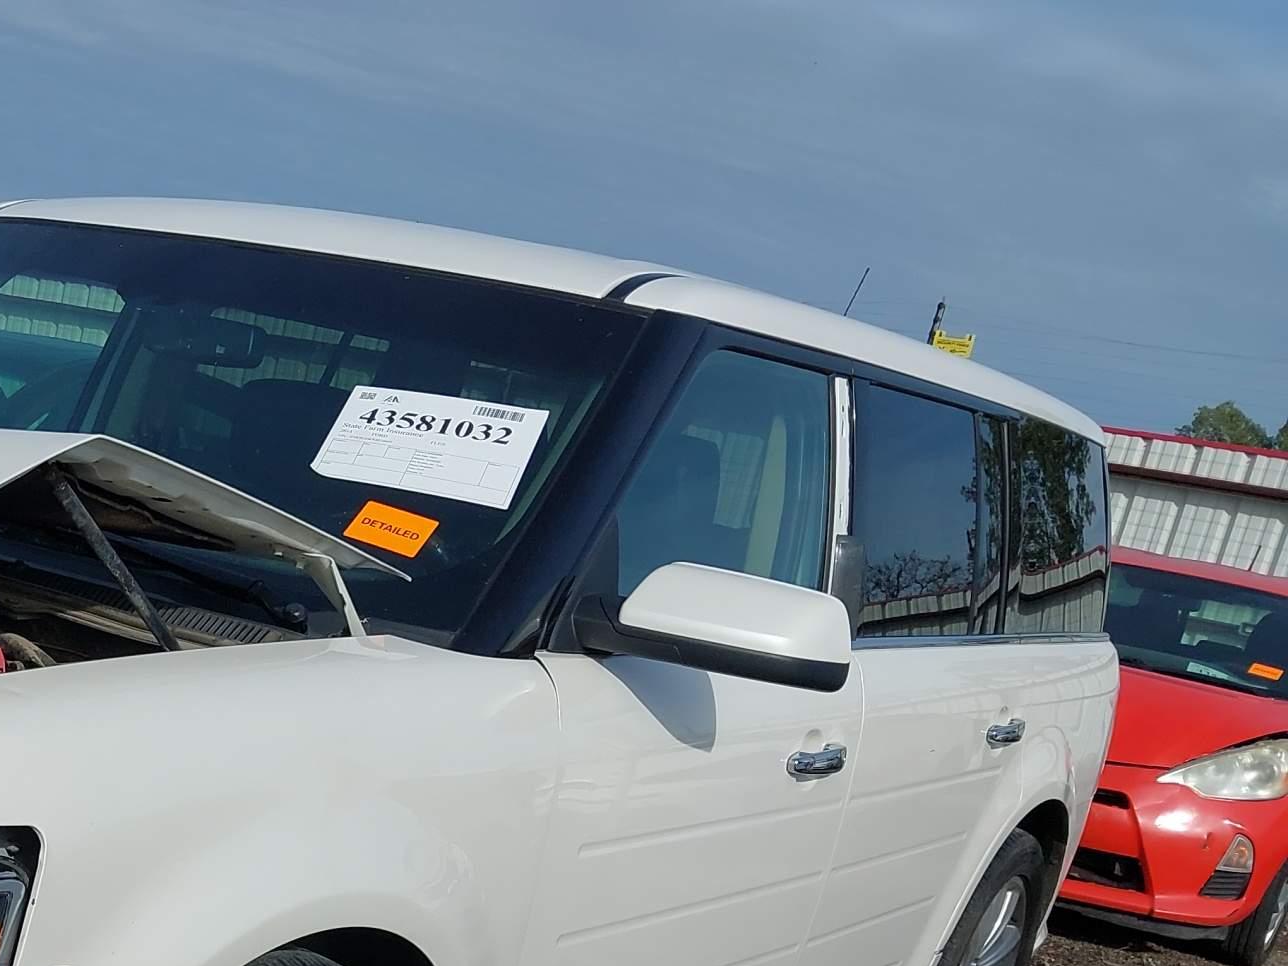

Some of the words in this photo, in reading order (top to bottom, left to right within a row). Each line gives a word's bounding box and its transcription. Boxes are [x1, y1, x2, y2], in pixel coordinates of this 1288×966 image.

[342, 422, 362, 430] State
[363, 424, 385, 432] Farm
[386, 428, 424, 438] Insurance
[359, 408, 513, 445] 43581032
[361, 517, 420, 541] DETAILED
